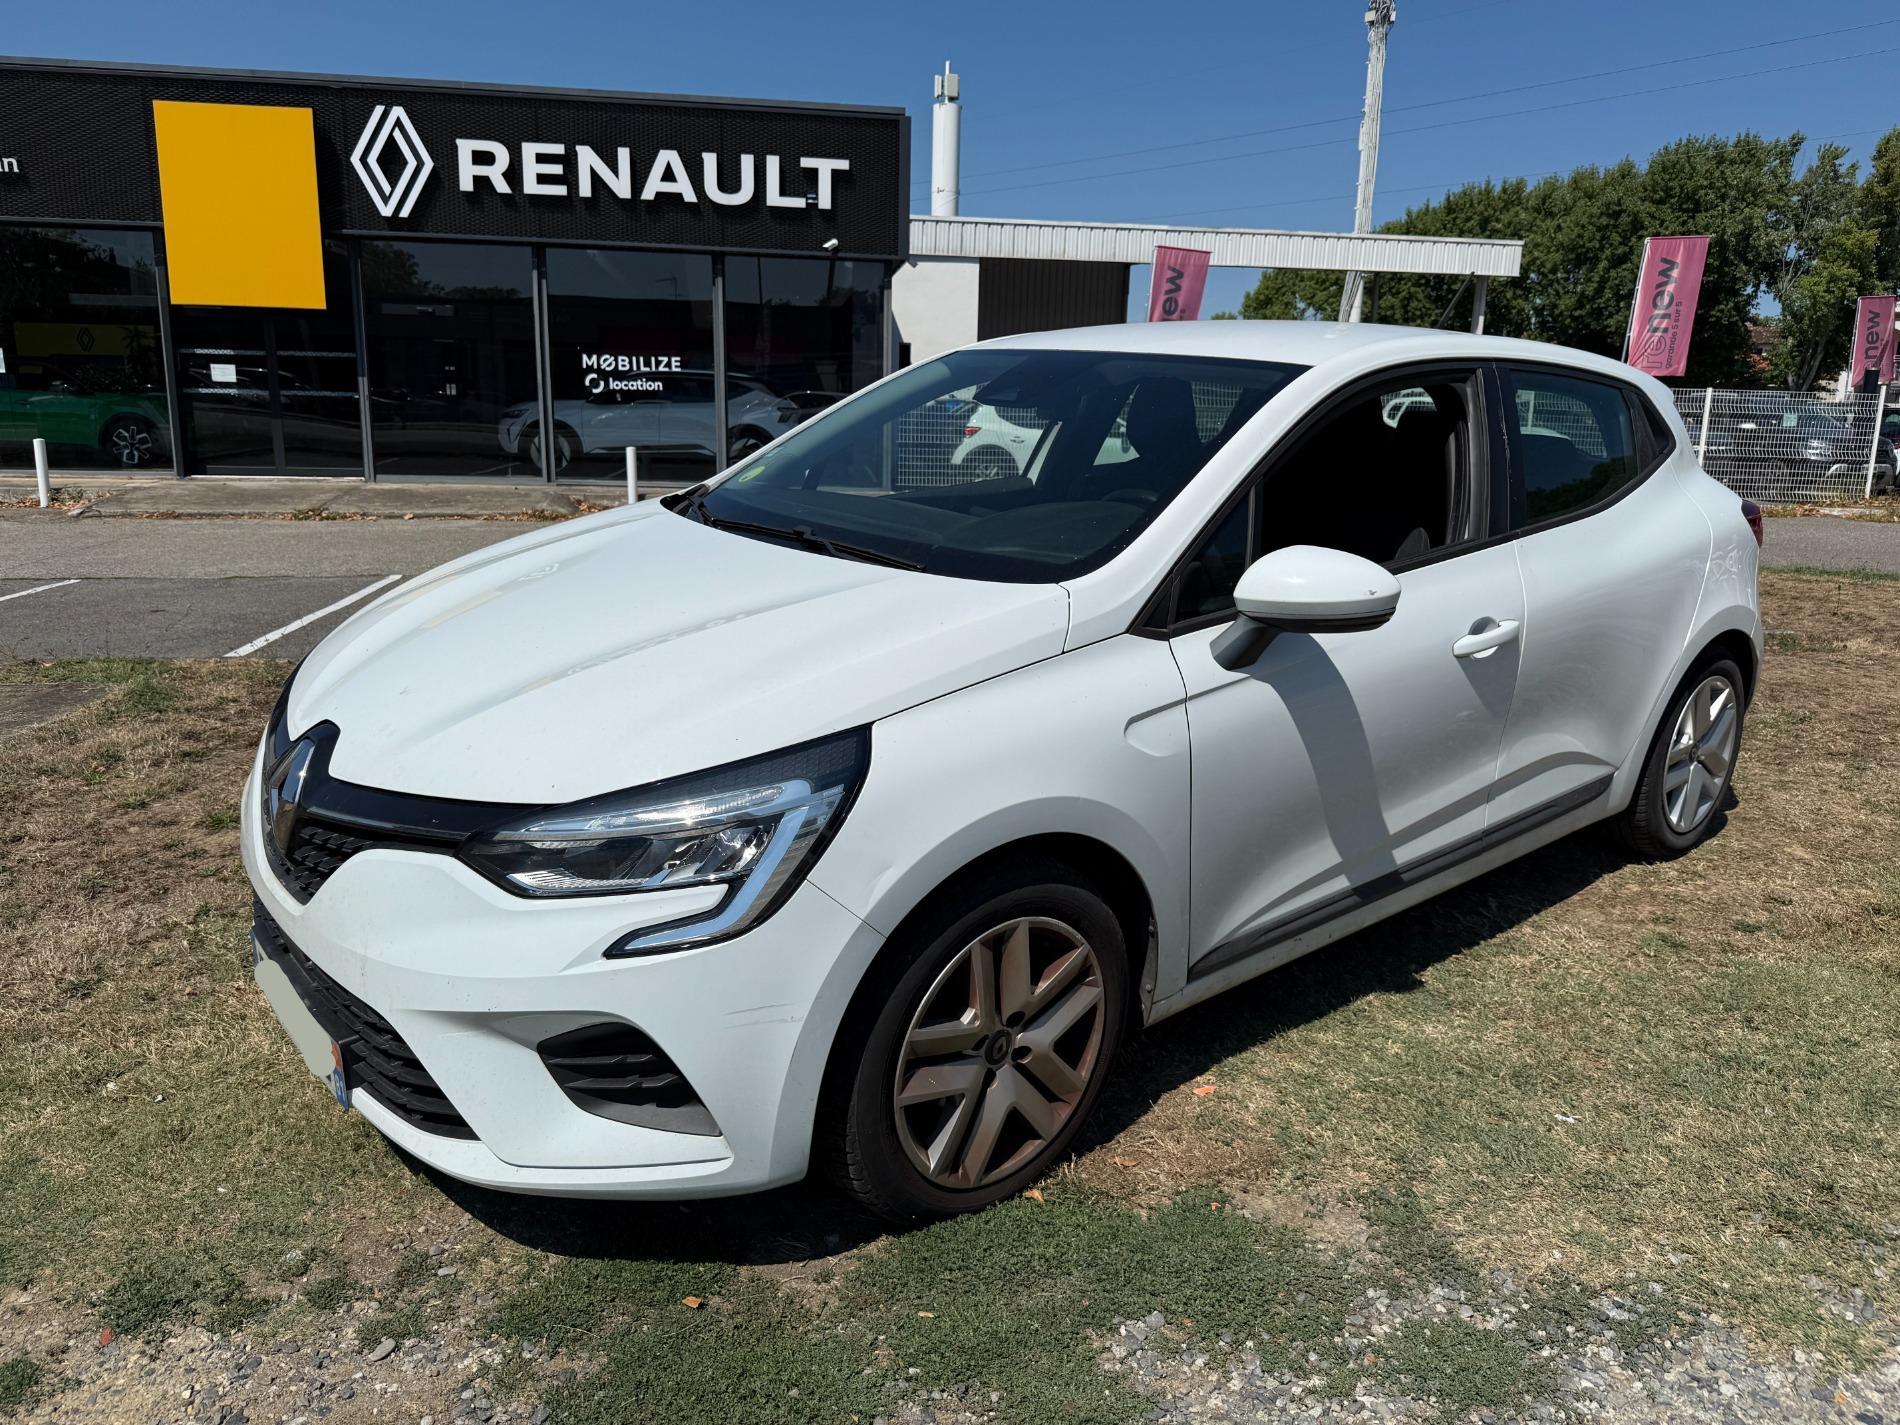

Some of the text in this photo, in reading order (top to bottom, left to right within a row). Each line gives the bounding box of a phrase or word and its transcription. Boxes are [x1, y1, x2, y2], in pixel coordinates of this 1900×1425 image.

[0, 157, 20, 173] n
[456, 138, 849, 210] RENAULT
[1162, 265, 1184, 321] ew
[1641, 256, 1679, 369] renew
[609, 377, 663, 391] location
